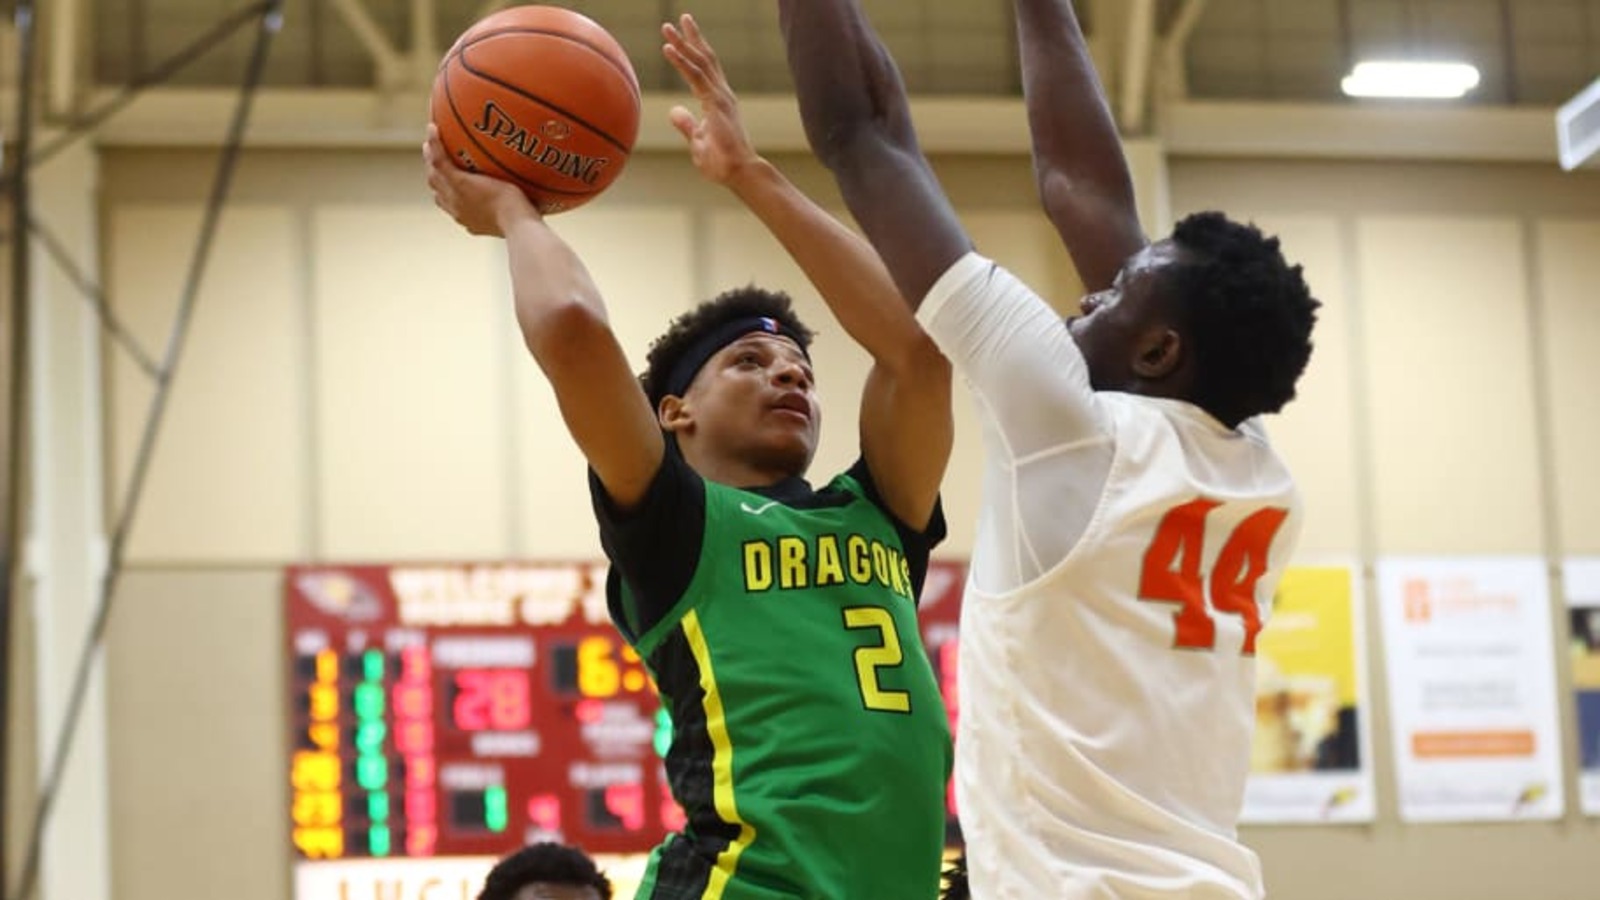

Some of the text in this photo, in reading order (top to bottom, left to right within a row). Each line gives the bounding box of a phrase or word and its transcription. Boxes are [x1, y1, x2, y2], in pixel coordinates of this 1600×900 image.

[474, 100, 606, 185] SPALDING
[742, 533, 914, 600] DRAGONS
[1137, 497, 1290, 656] 44
[453, 666, 531, 732] 28
[842, 604, 913, 715] 2
